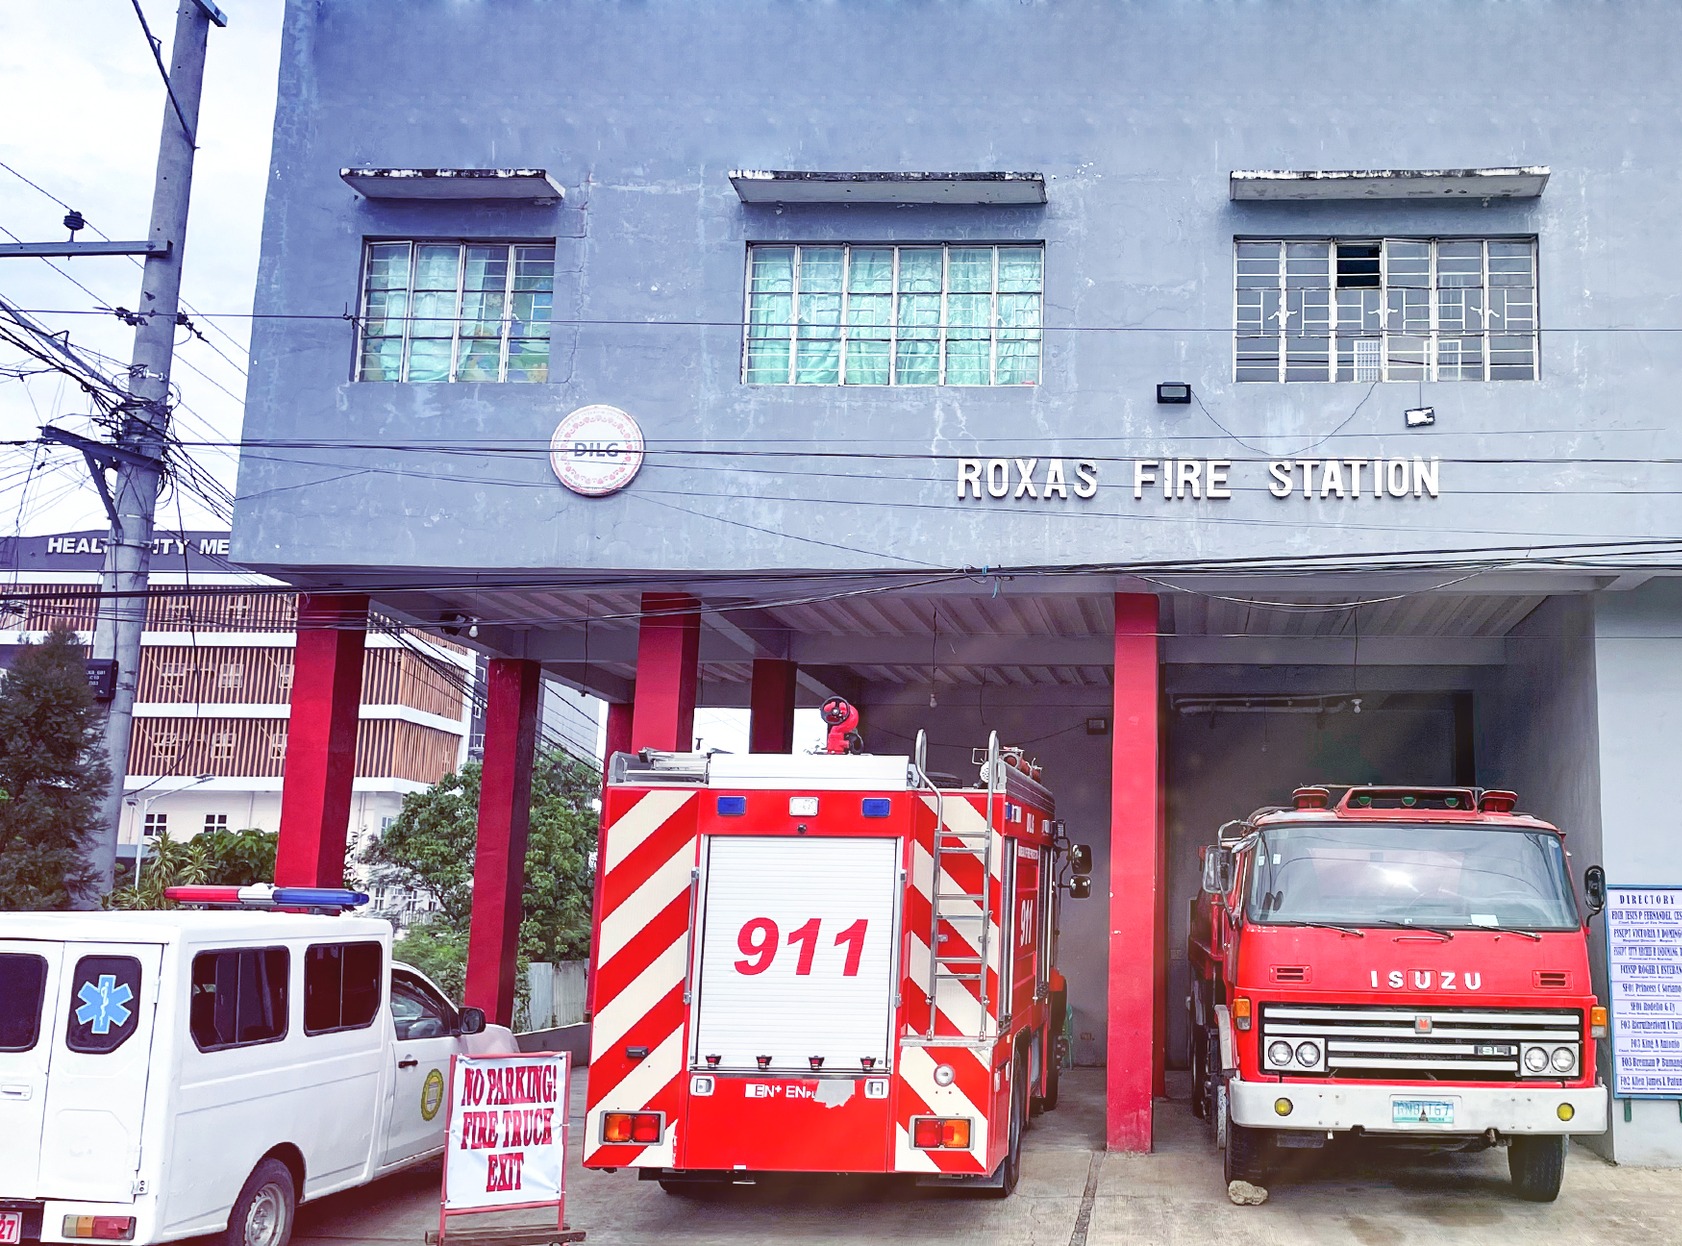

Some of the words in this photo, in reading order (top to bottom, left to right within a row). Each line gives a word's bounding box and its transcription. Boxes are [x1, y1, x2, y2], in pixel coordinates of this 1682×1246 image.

[574, 442, 619, 458] DILG
[956, 457, 1098, 499] ROXAS
[1133, 458, 1233, 500] FIRE
[1268, 456, 1440, 499] STATION
[1620, 894, 1675, 905] DIRECTORY
[733, 917, 869, 977] 911
[1370, 970, 1482, 990] ISUZU
[461, 1067, 485, 1107] NO
[486, 1064, 558, 1106] PARKING!
[461, 1110, 499, 1150] FIRE
[503, 1107, 554, 1148] TRUCK
[486, 1151, 525, 1193] EXIT
